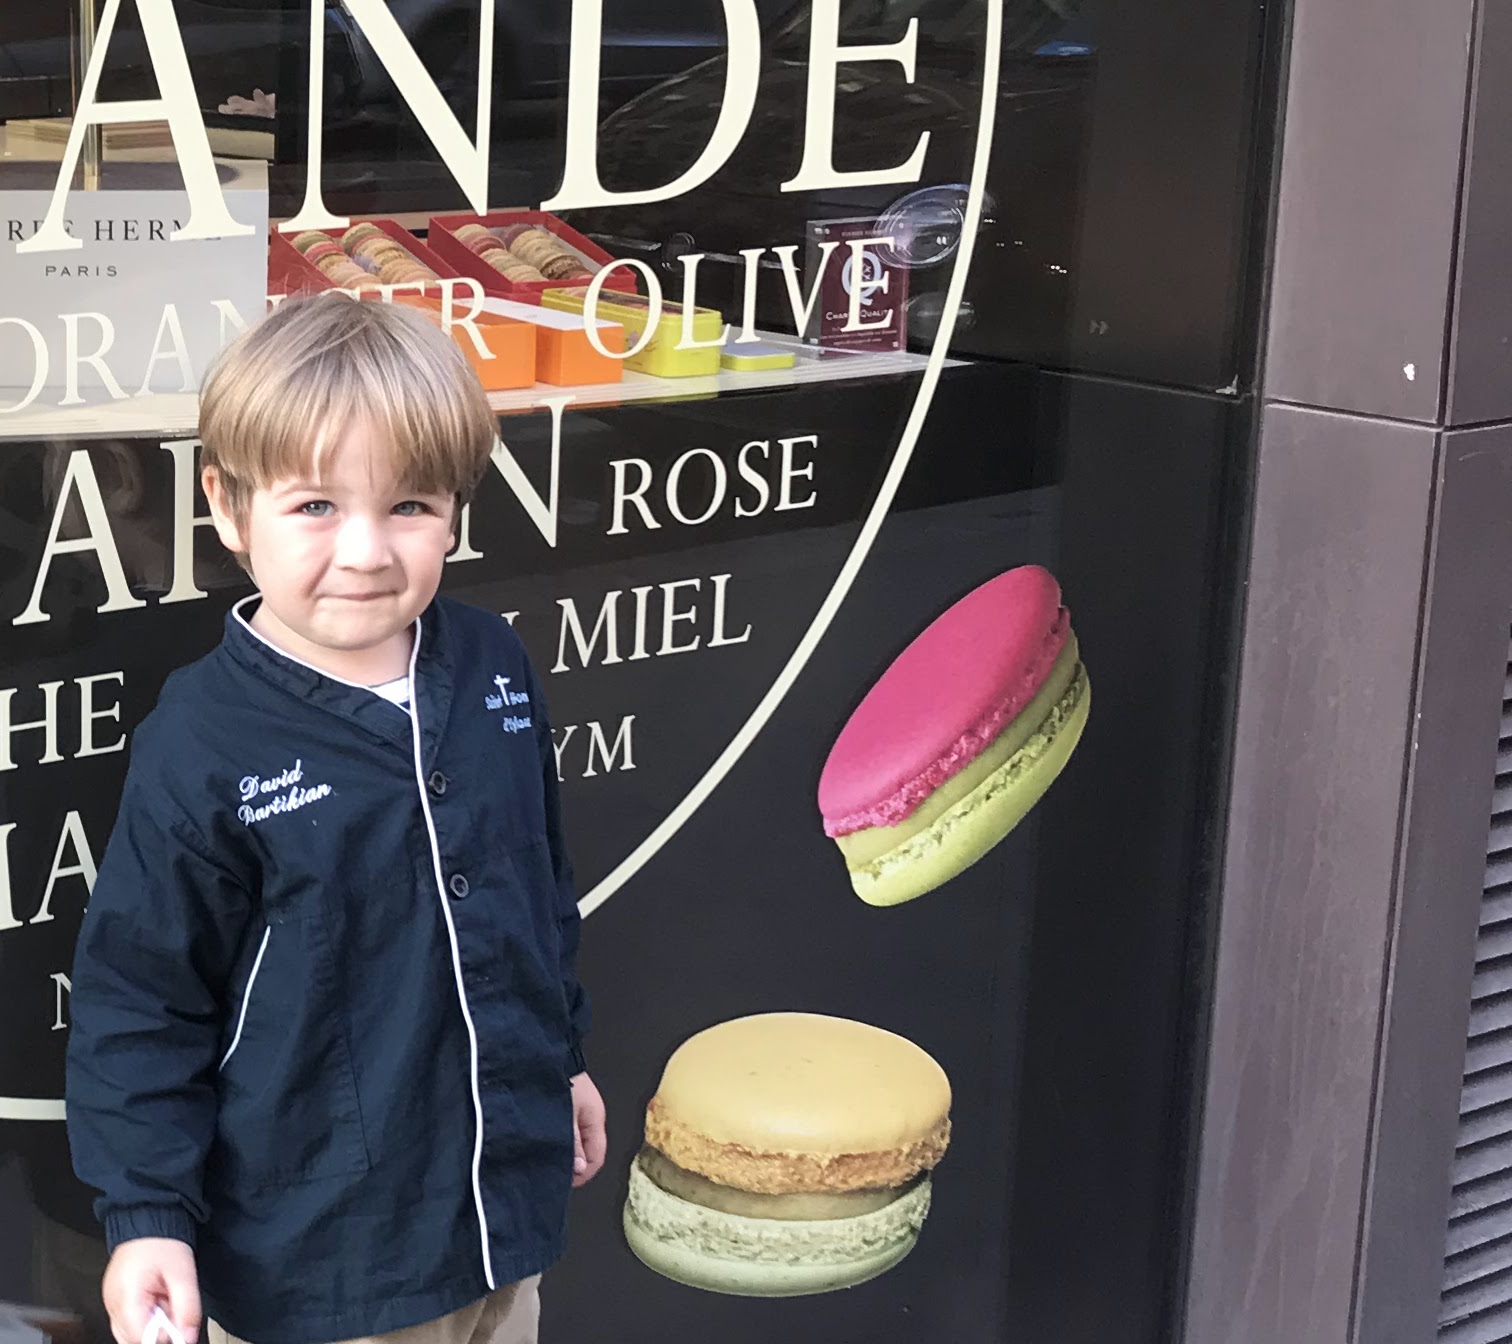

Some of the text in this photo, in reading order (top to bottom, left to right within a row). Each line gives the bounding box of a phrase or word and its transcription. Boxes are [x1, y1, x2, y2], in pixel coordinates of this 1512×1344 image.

[44, 265, 118, 278] PARIS
[584, 235, 894, 359] OLIVE
[606, 434, 819, 536] ROSE
[550, 573, 753, 674] MIEL
[238, 758, 305, 802] David
[550, 715, 638, 783] YM
[237, 782, 333, 827] Bartikian
